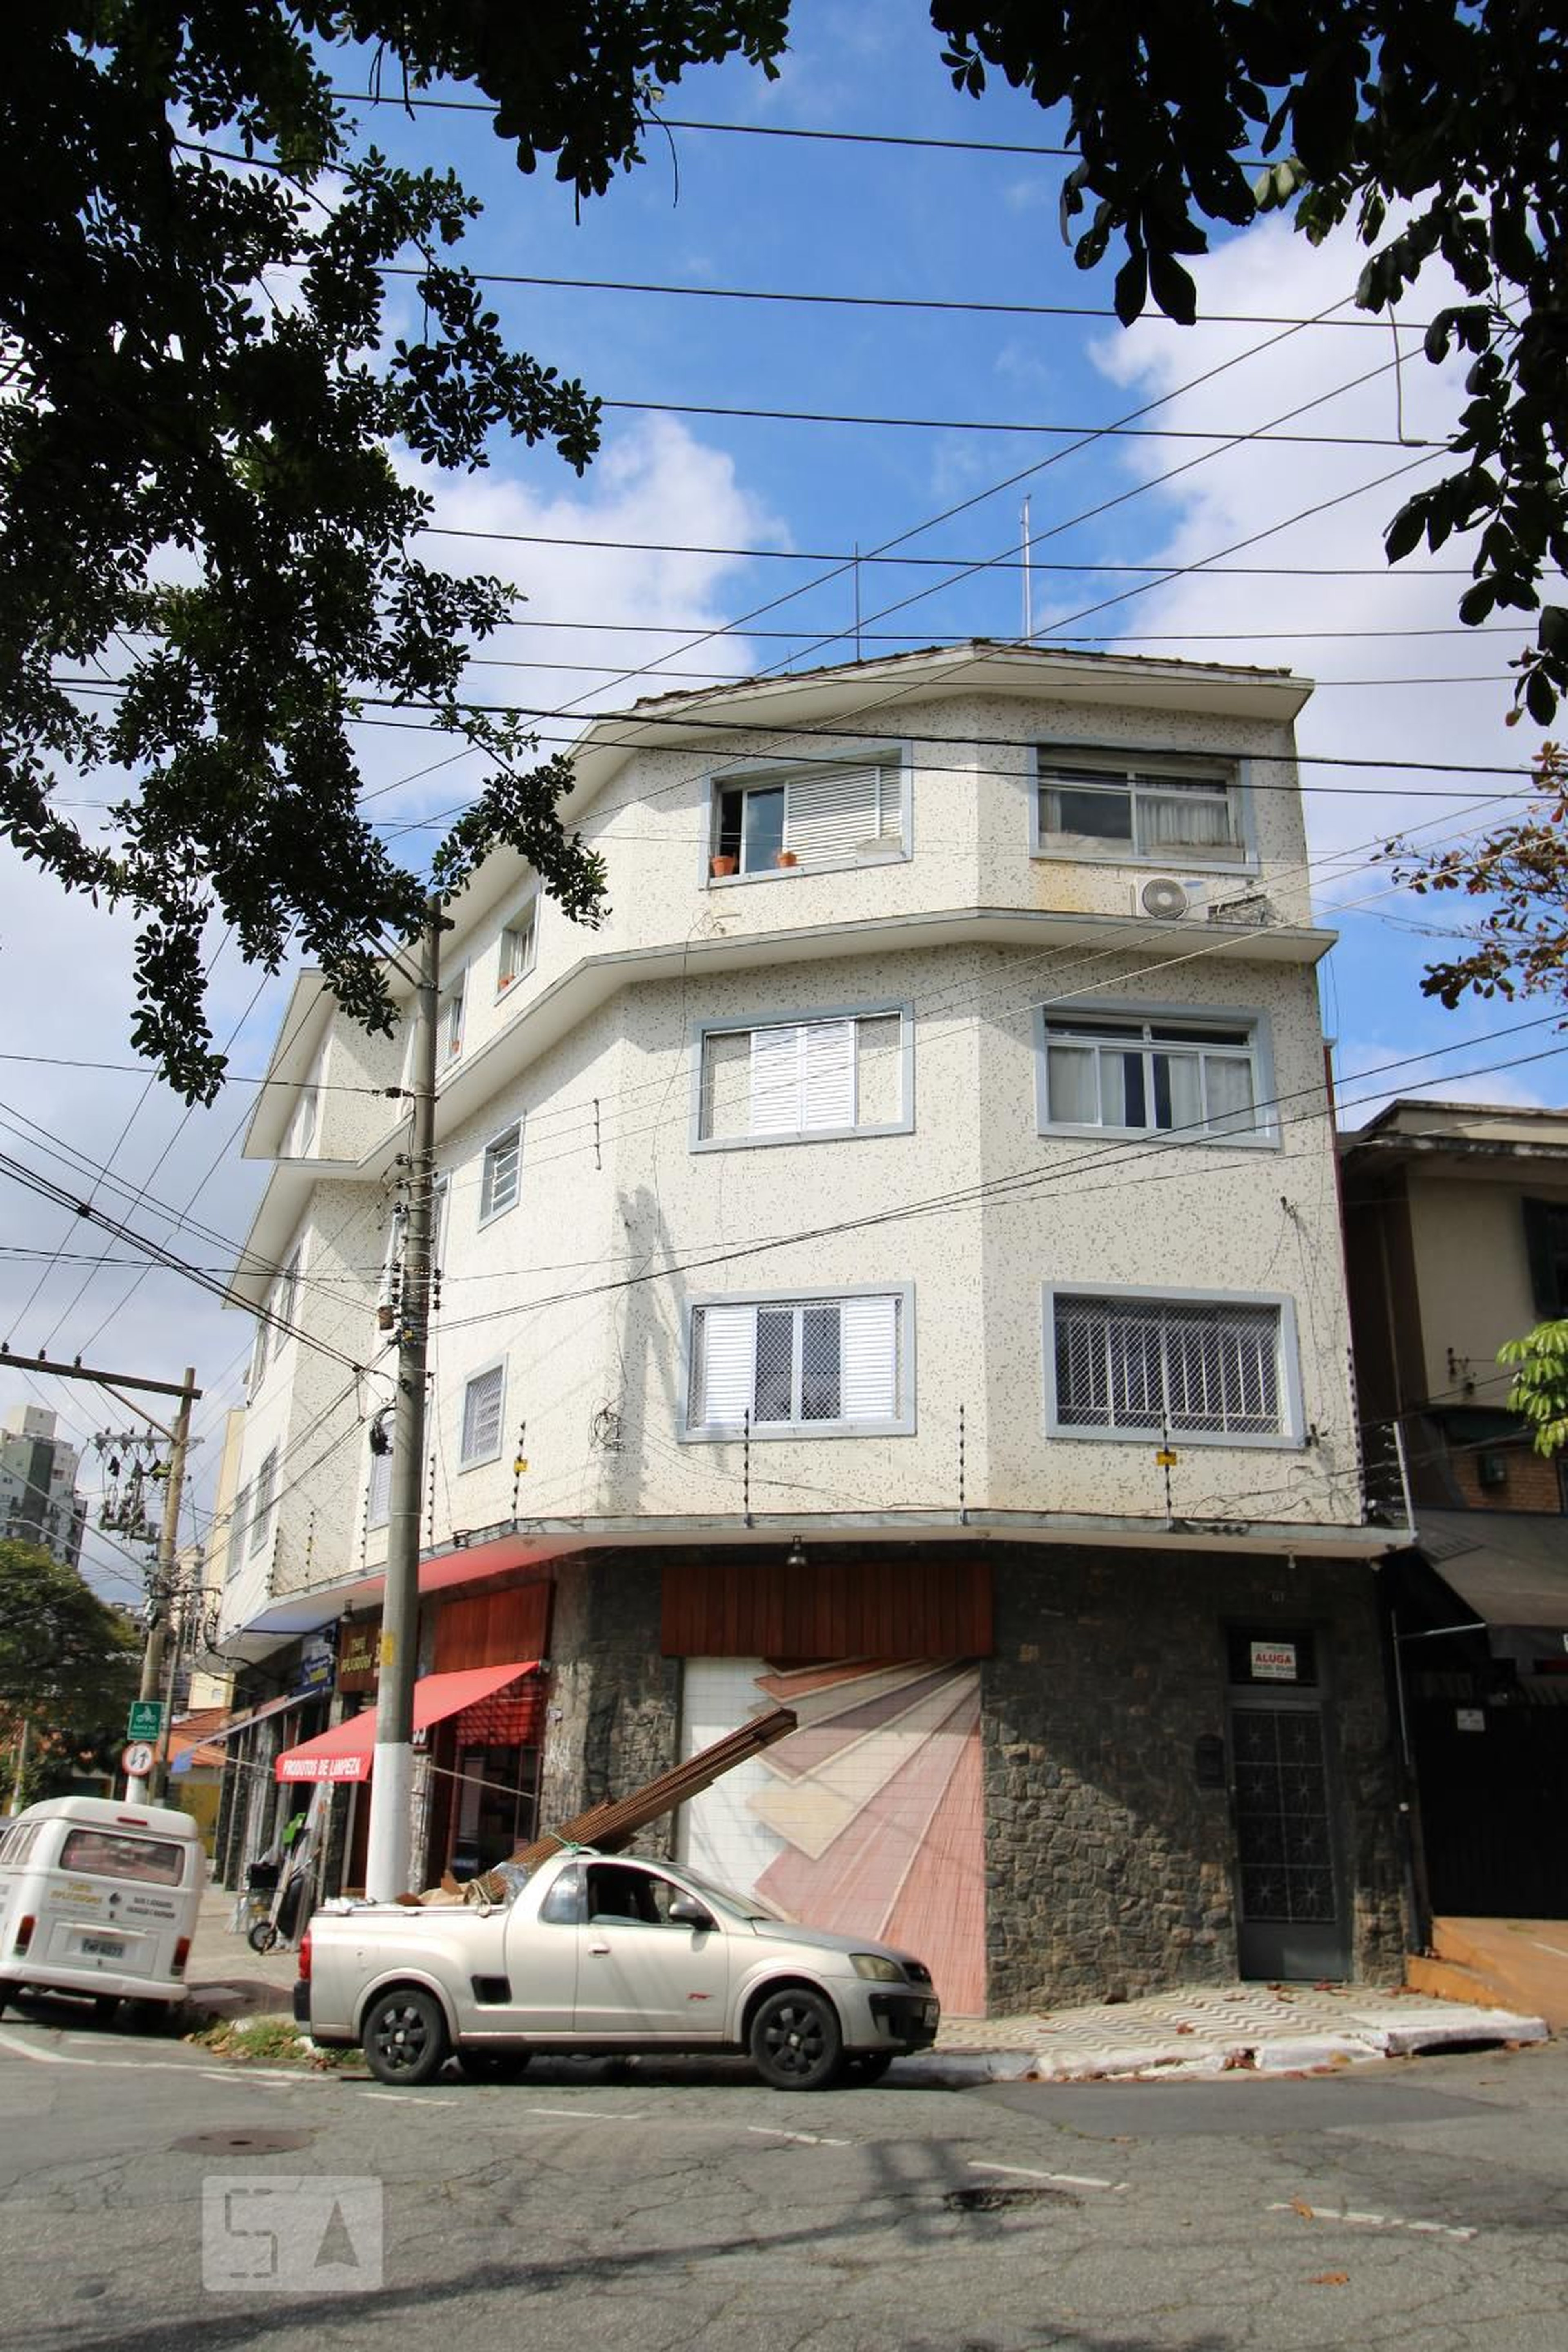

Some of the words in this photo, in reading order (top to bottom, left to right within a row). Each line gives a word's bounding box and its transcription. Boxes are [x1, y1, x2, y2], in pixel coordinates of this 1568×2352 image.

[1255, 1653, 1292, 1665] ALUGA
[283, 1759, 318, 1776] PRODUTOS
[318, 1759, 330, 1775] DE
[330, 1757, 361, 1776] LIMPEZA
